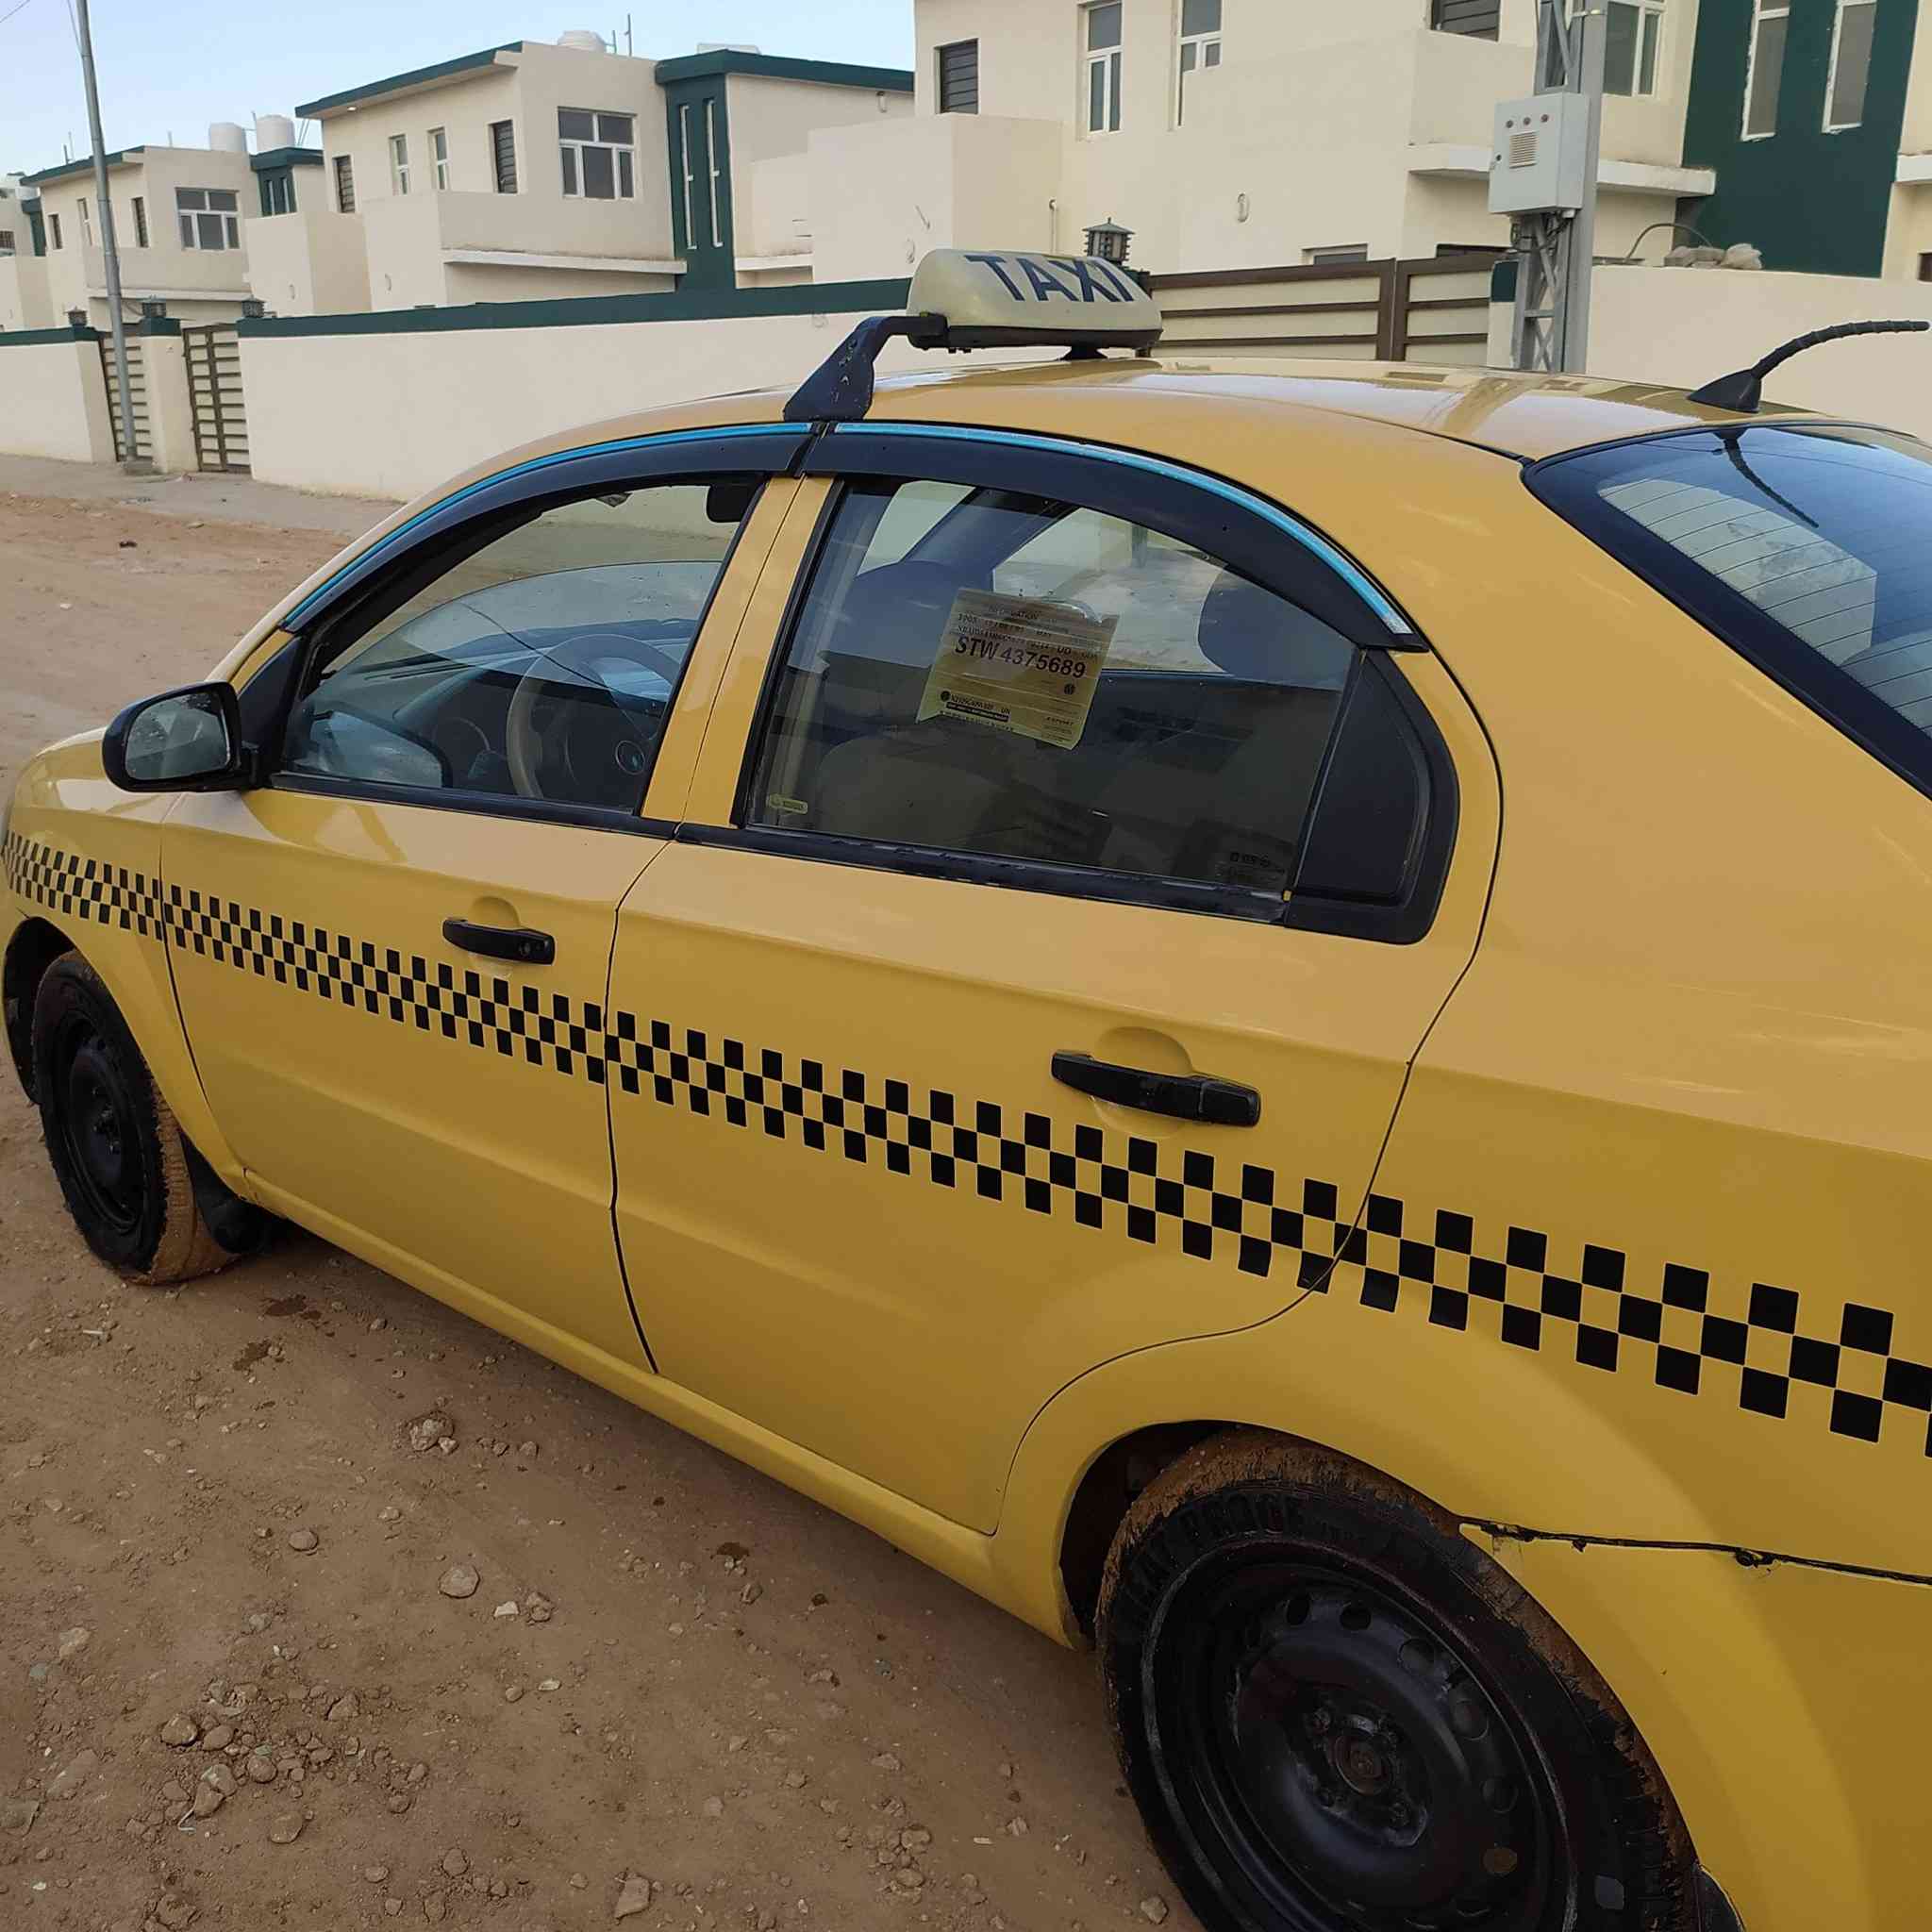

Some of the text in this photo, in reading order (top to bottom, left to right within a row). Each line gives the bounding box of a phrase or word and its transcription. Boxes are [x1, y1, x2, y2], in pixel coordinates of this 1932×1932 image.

[965, 255, 1136, 302] TAXI
[955, 636, 999, 660] STW
[1001, 647, 1086, 679] 4375689
